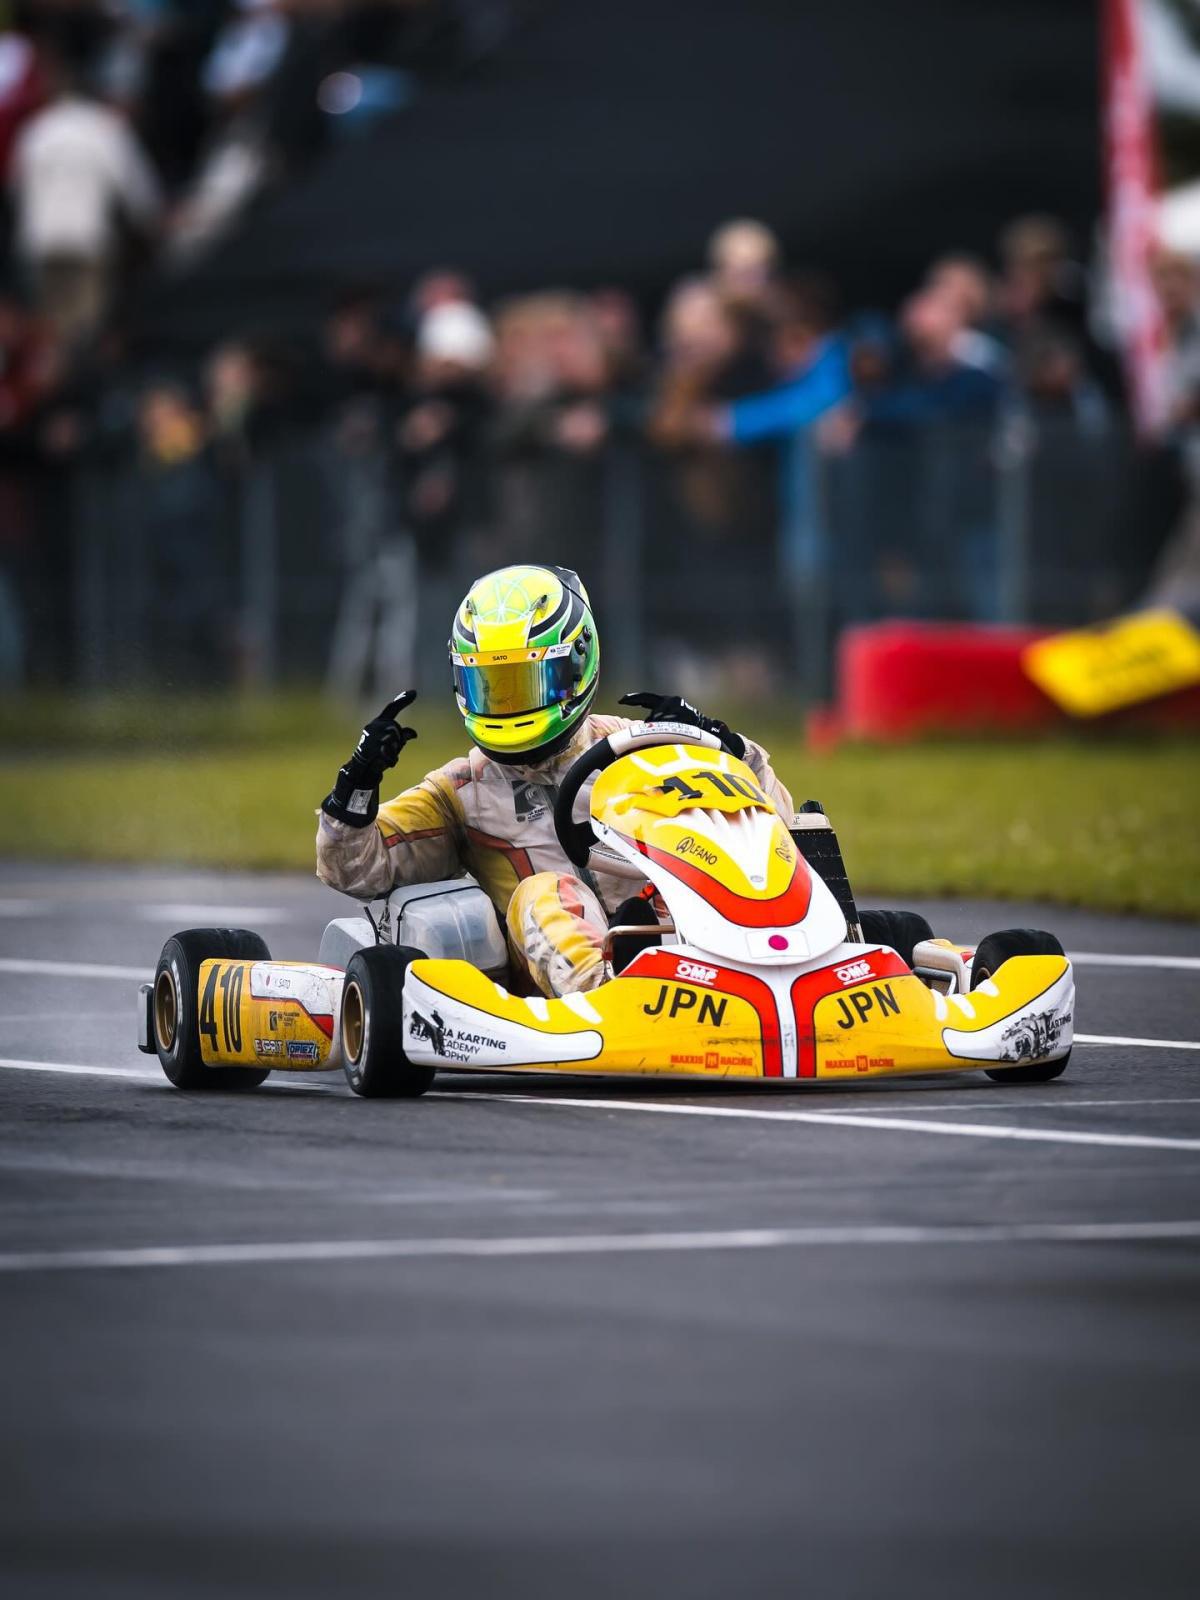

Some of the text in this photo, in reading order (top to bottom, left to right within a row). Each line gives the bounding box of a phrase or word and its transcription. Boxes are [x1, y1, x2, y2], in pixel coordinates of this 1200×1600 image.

[654, 771, 767, 804] 410
[676, 836, 718, 865] ALFANO
[676, 962, 718, 981] OMP
[836, 962, 871, 982] OMP
[200, 964, 244, 1053] 410
[643, 985, 728, 1027] JPN
[837, 983, 901, 1030] JPN
[442, 1038, 481, 1055] CADEMY
[457, 1031, 507, 1051] KARTING
[670, 1055, 704, 1064] MAXXIS
[720, 1056, 753, 1066] RACING
